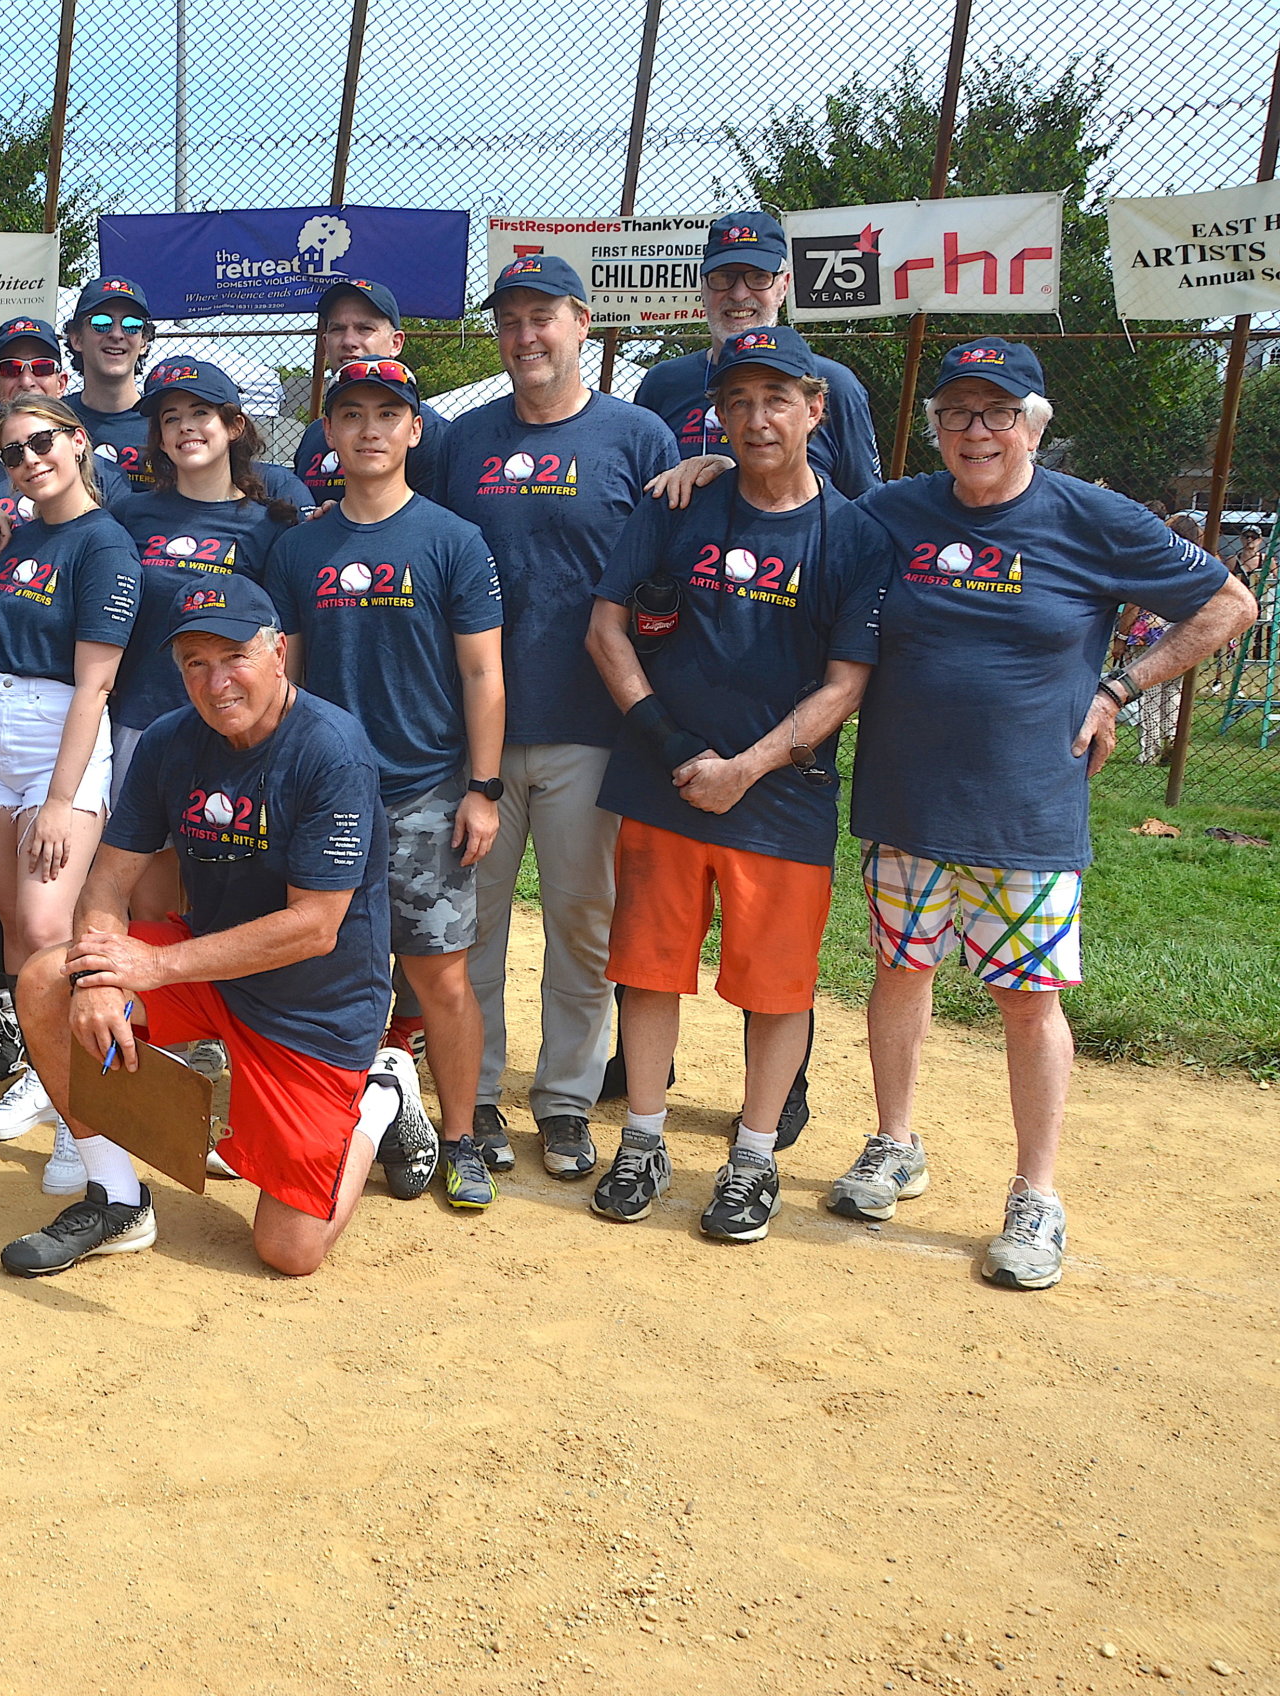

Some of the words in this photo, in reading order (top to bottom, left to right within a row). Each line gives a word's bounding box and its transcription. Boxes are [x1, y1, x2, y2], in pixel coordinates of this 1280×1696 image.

[1191, 217, 1257, 238] EAST
[216, 249, 240, 263] the
[592, 246, 628, 258] FIRST
[1130, 241, 1267, 269] ARTISTS
[216, 255, 300, 280] retreat
[805, 250, 866, 291] 75
[893, 231, 1053, 301] rhr
[216, 279, 262, 290] DOMESTIC
[264, 274, 308, 286] VIOLENCE
[1178, 268, 1256, 289] Annual
[185, 292, 219, 303] Where
[221, 289, 265, 300] violence
[267, 289, 292, 299] ends
[294, 285, 315, 297] and
[591, 294, 703, 303] FOUNDATIO
[809, 291, 867, 302] YEARS
[640, 311, 671, 321] Wear
[673, 309, 689, 320] FR
[476, 485, 518, 496] ARTISTS
[520, 486, 528, 495] &
[531, 485, 578, 497] WRITERS
[178, 560, 187, 568] &
[189, 560, 233, 576] WRITERS
[903, 571, 950, 587] ARTISTS
[952, 578, 963, 588] &
[966, 579, 1023, 595] WRITERS
[689, 575, 735, 594] ARTISTS
[737, 586, 747, 597] &
[749, 590, 798, 608] WRITERS
[316, 597, 358, 609] ARTISTS
[360, 597, 369, 607] &
[371, 597, 415, 608] WRITERS
[221, 832, 232, 843] &
